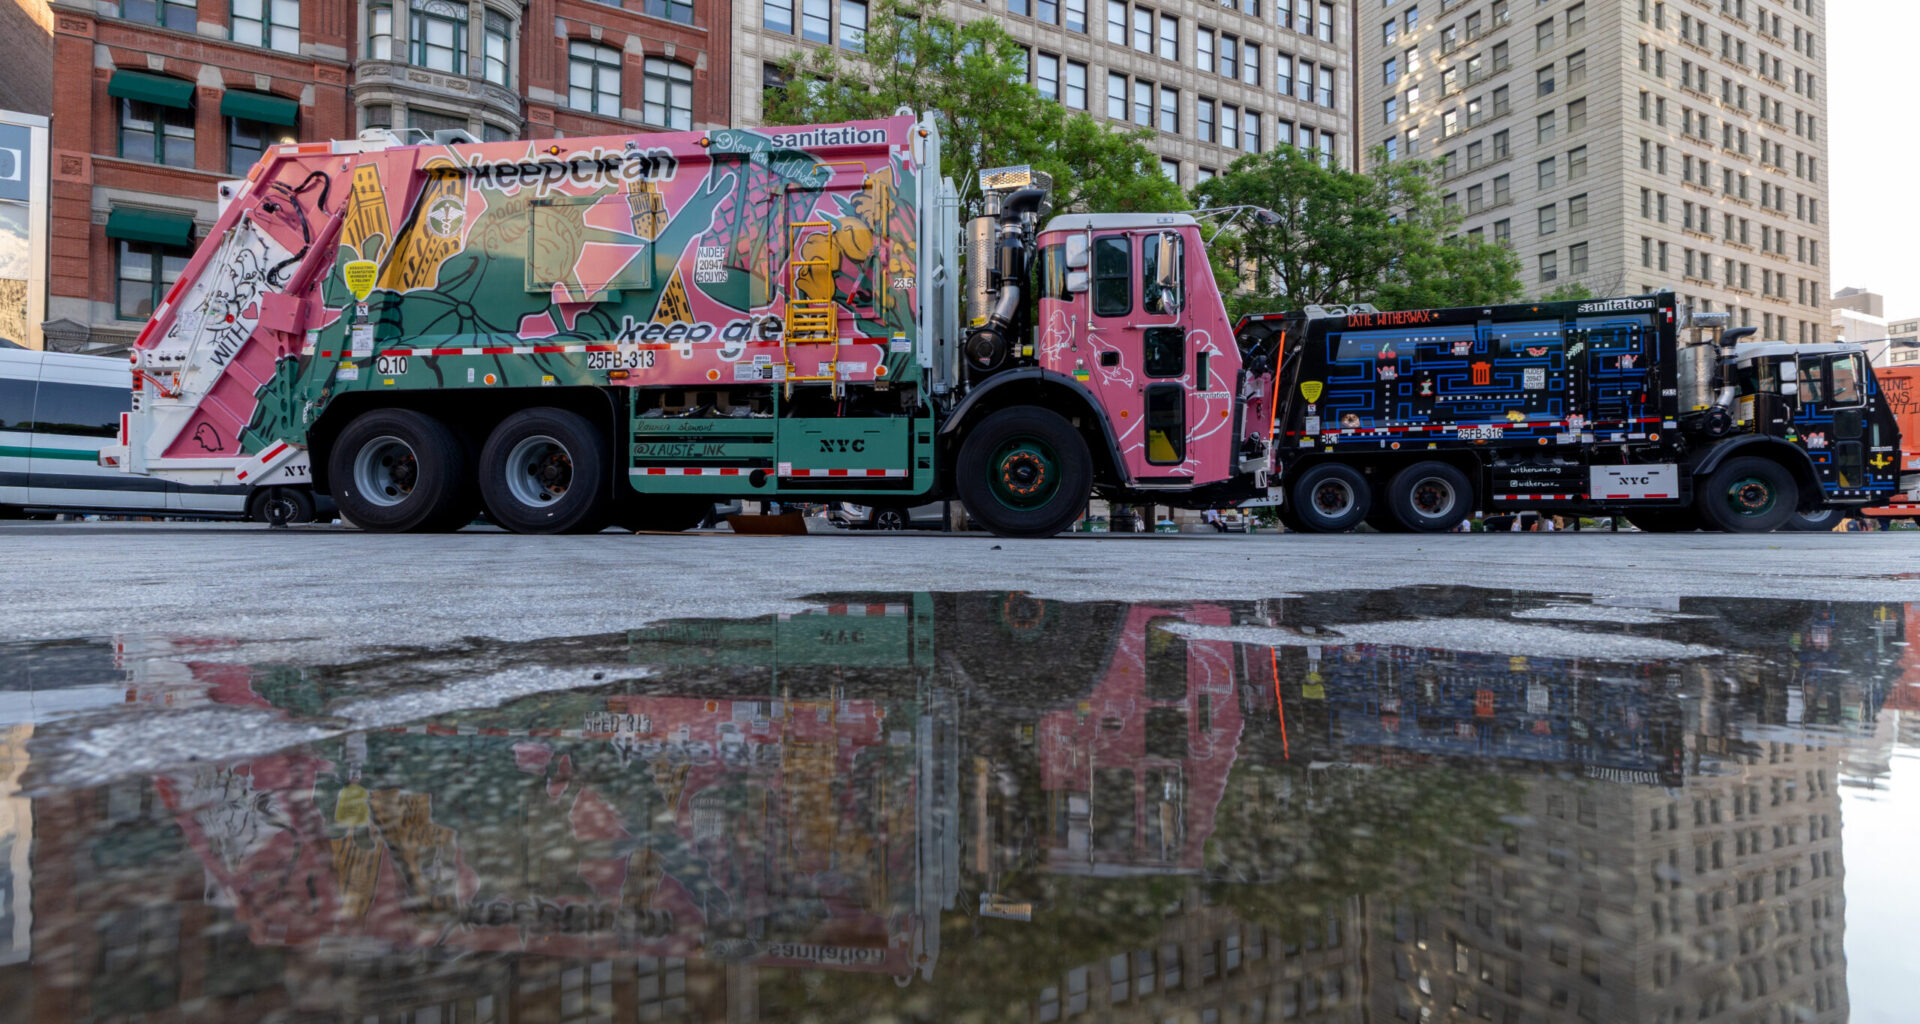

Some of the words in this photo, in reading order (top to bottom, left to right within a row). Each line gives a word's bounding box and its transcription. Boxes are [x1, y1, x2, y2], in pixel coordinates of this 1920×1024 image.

[771, 127, 886, 148] sanitation
[697, 246, 725, 258] NJDEP
[699, 259, 723, 270] 20947
[1578, 299, 1655, 313] sanitation
[1377, 309, 1431, 326] WITHERWAX
[209, 320, 249, 366] WITH
[618, 317, 714, 357] keep
[377, 357, 408, 374] Q.10
[587, 351, 655, 369] 25FB-313
[1458, 428, 1504, 440] 25FB-316
[634, 443, 727, 456] @LAUSTE_INK
[820, 439, 865, 452] NYC
[284, 465, 312, 478] NY
[1619, 477, 1650, 486] NYC
